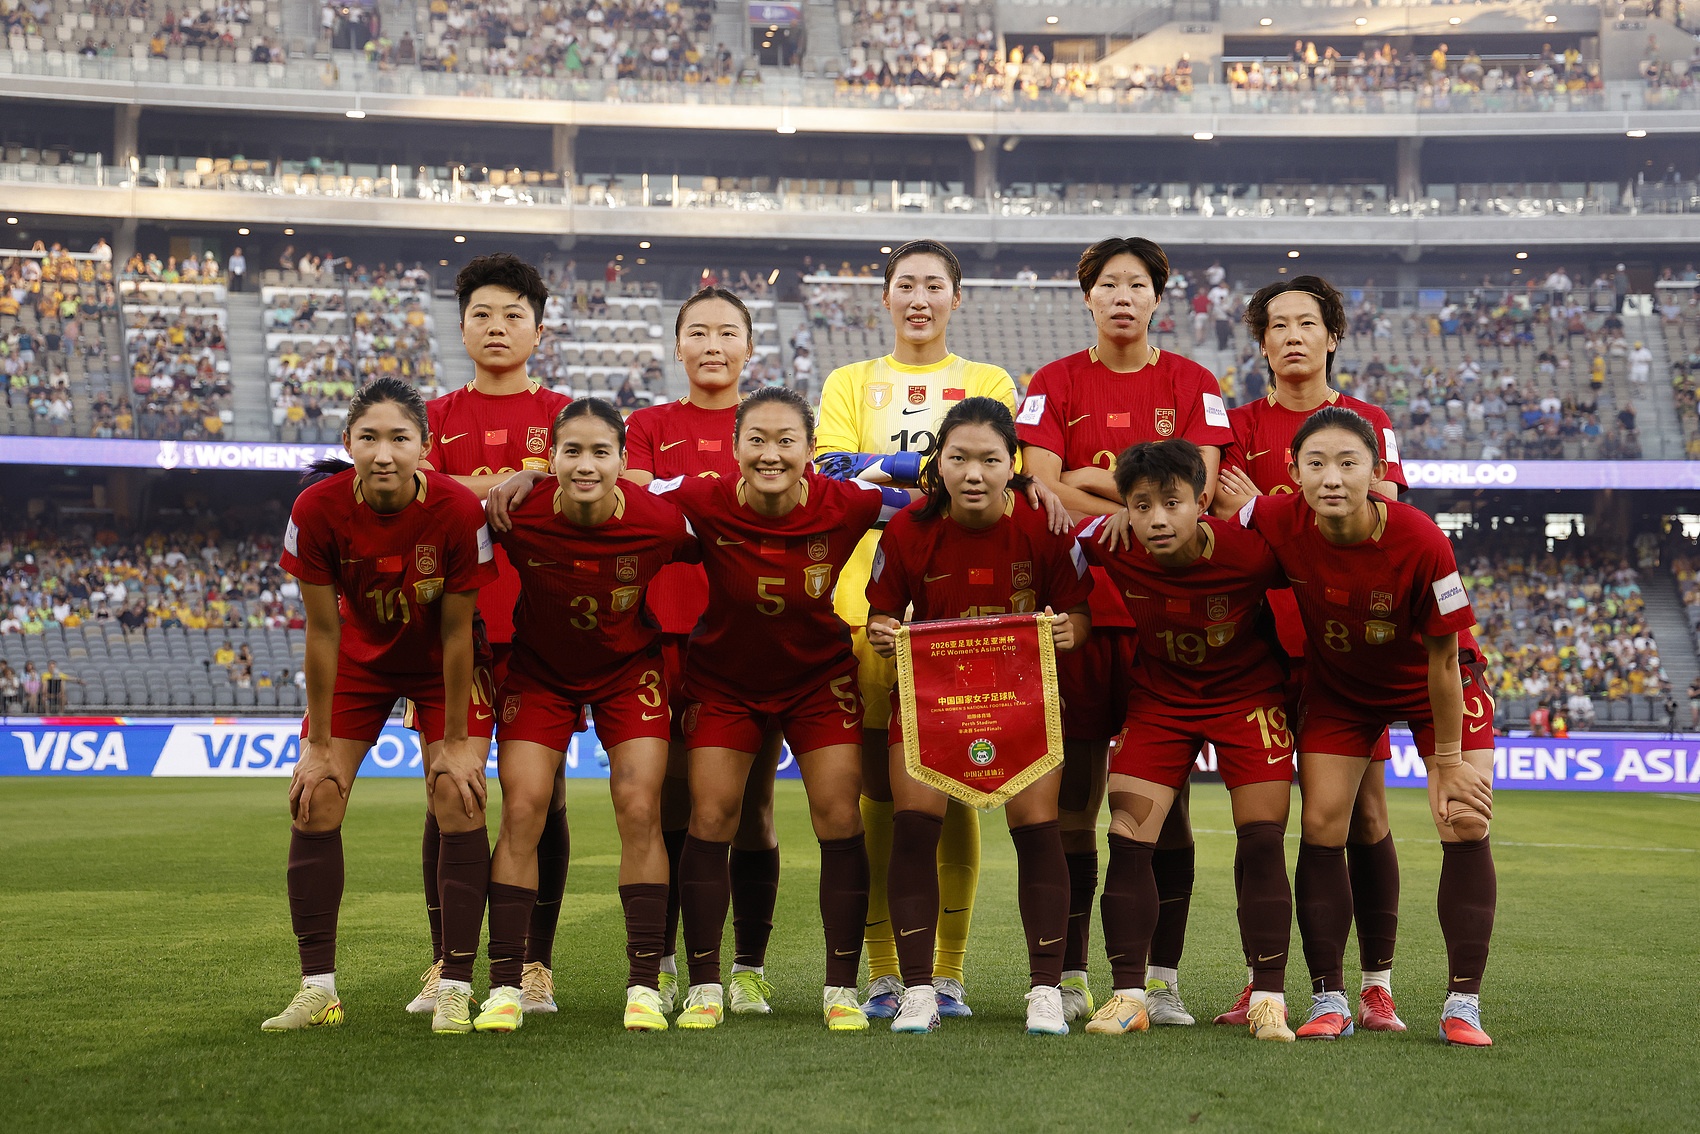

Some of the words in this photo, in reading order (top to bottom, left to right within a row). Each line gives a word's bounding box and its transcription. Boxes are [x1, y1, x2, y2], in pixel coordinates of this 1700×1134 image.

[195, 444, 316, 469] WOMEN'S
[365, 586, 411, 625] 10
[570, 595, 599, 631] 3
[756, 576, 786, 616] 5
[947, 647, 980, 656] Women's
[980, 645, 1001, 653] Asian
[1155, 629, 1207, 666] 19
[1323, 619, 1352, 653] 8
[637, 669, 662, 708] 3
[829, 675, 857, 714] 5
[937, 691, 1017, 706] 中国国家女子足球队
[1246, 706, 1291, 749] 19
[11, 730, 129, 772] VISA
[193, 733, 300, 769] VISA
